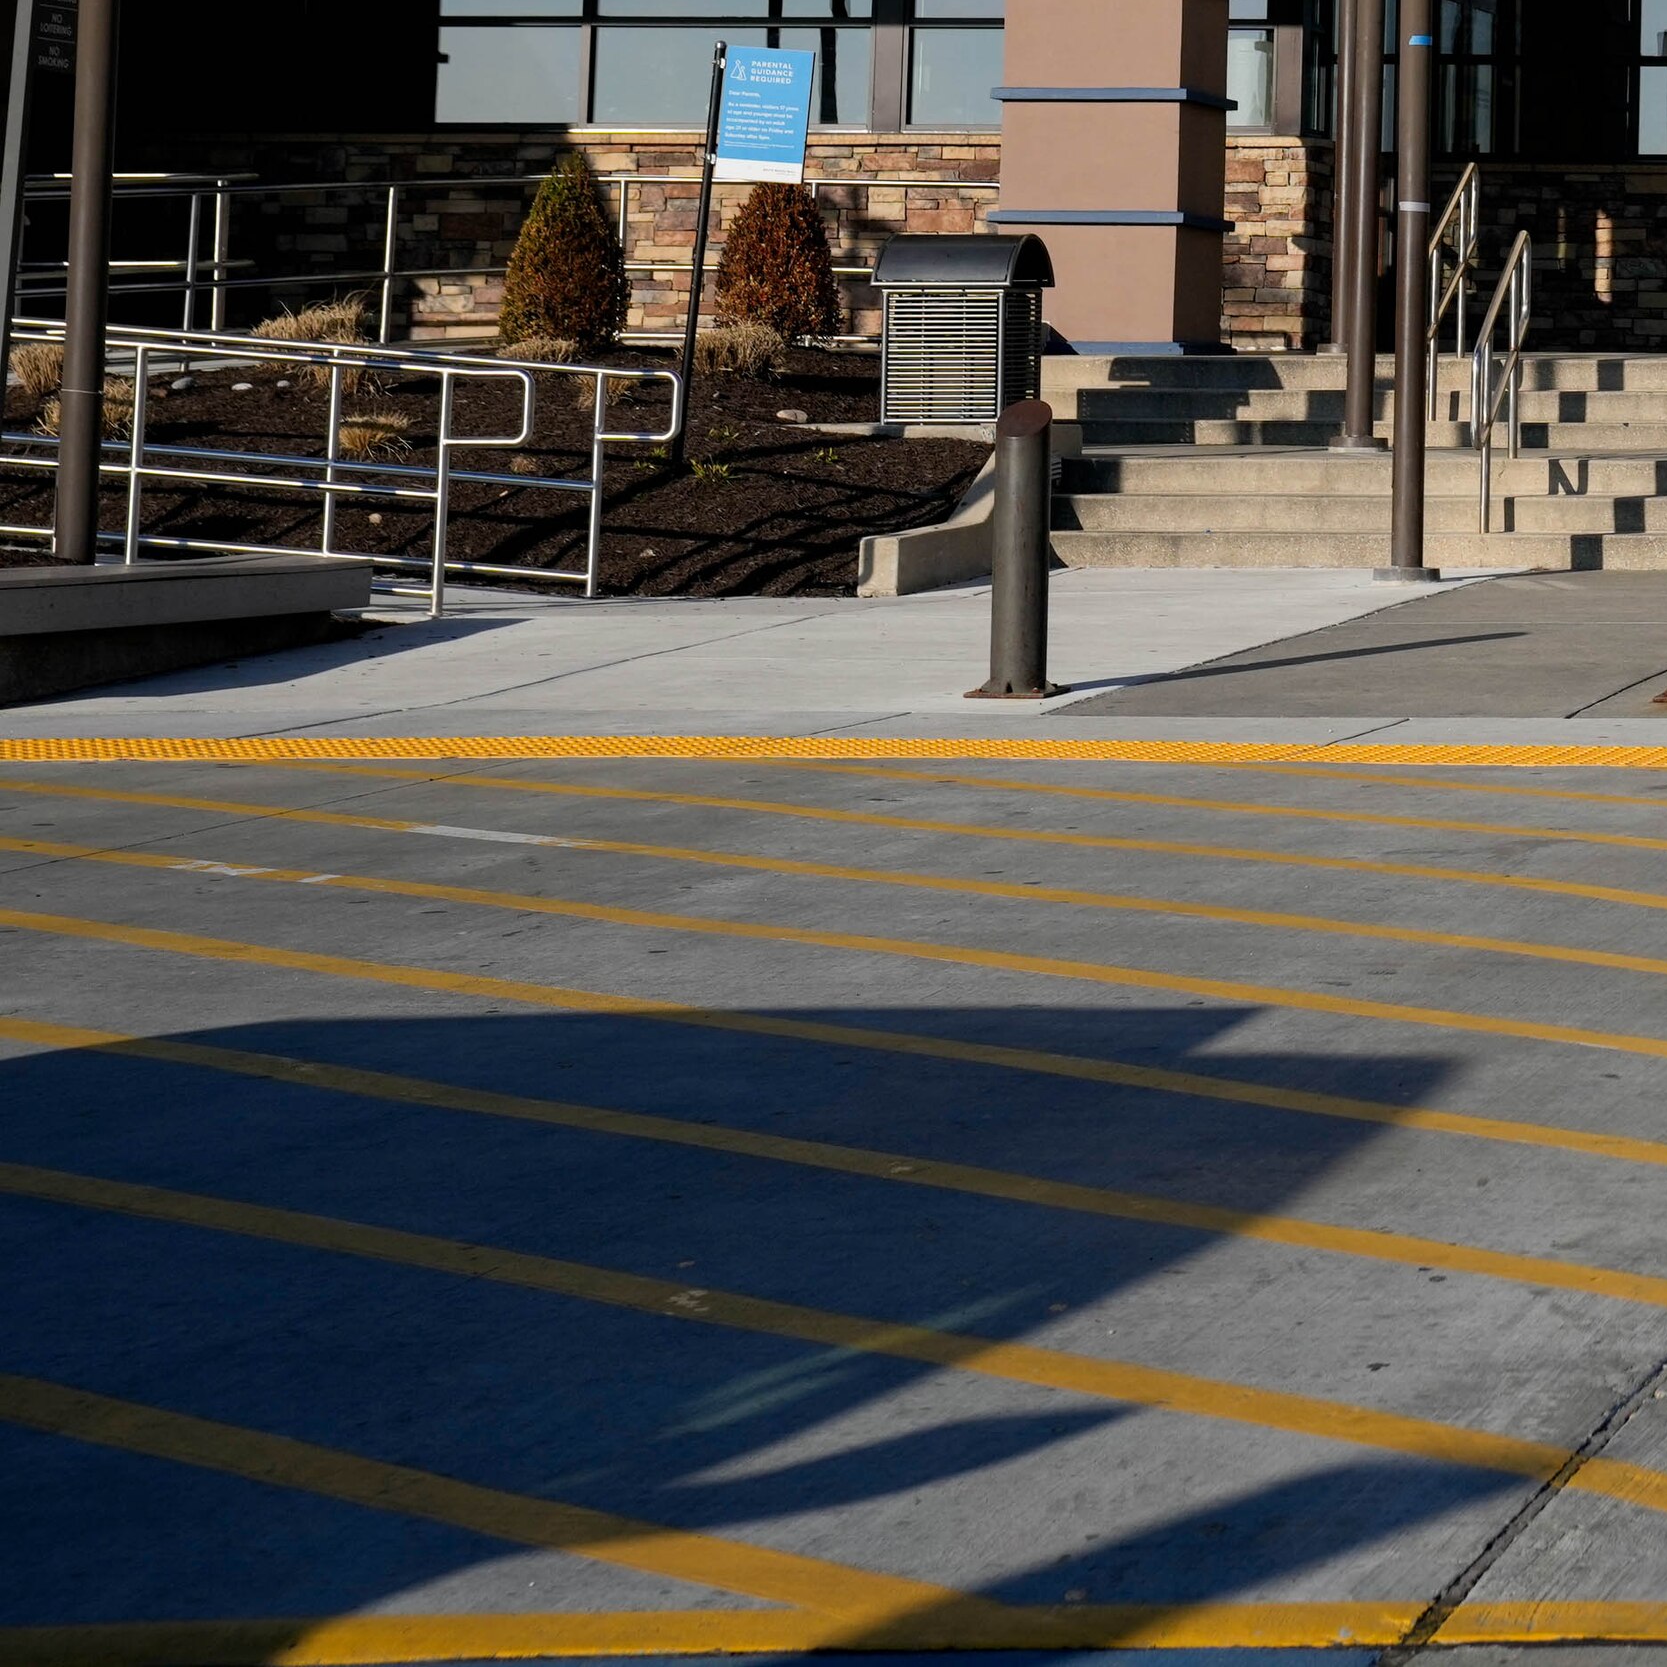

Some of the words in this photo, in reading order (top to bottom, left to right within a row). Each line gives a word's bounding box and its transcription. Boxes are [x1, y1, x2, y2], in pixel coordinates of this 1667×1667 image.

[51, 13, 63, 24] NO
[49, 46, 61, 56] NO
[38, 56, 69, 69] SMOKING
[751, 60, 793, 70] PARENTAL
[751, 68, 793, 77] GUIDANCE
[750, 76, 792, 85] REQUIRED
